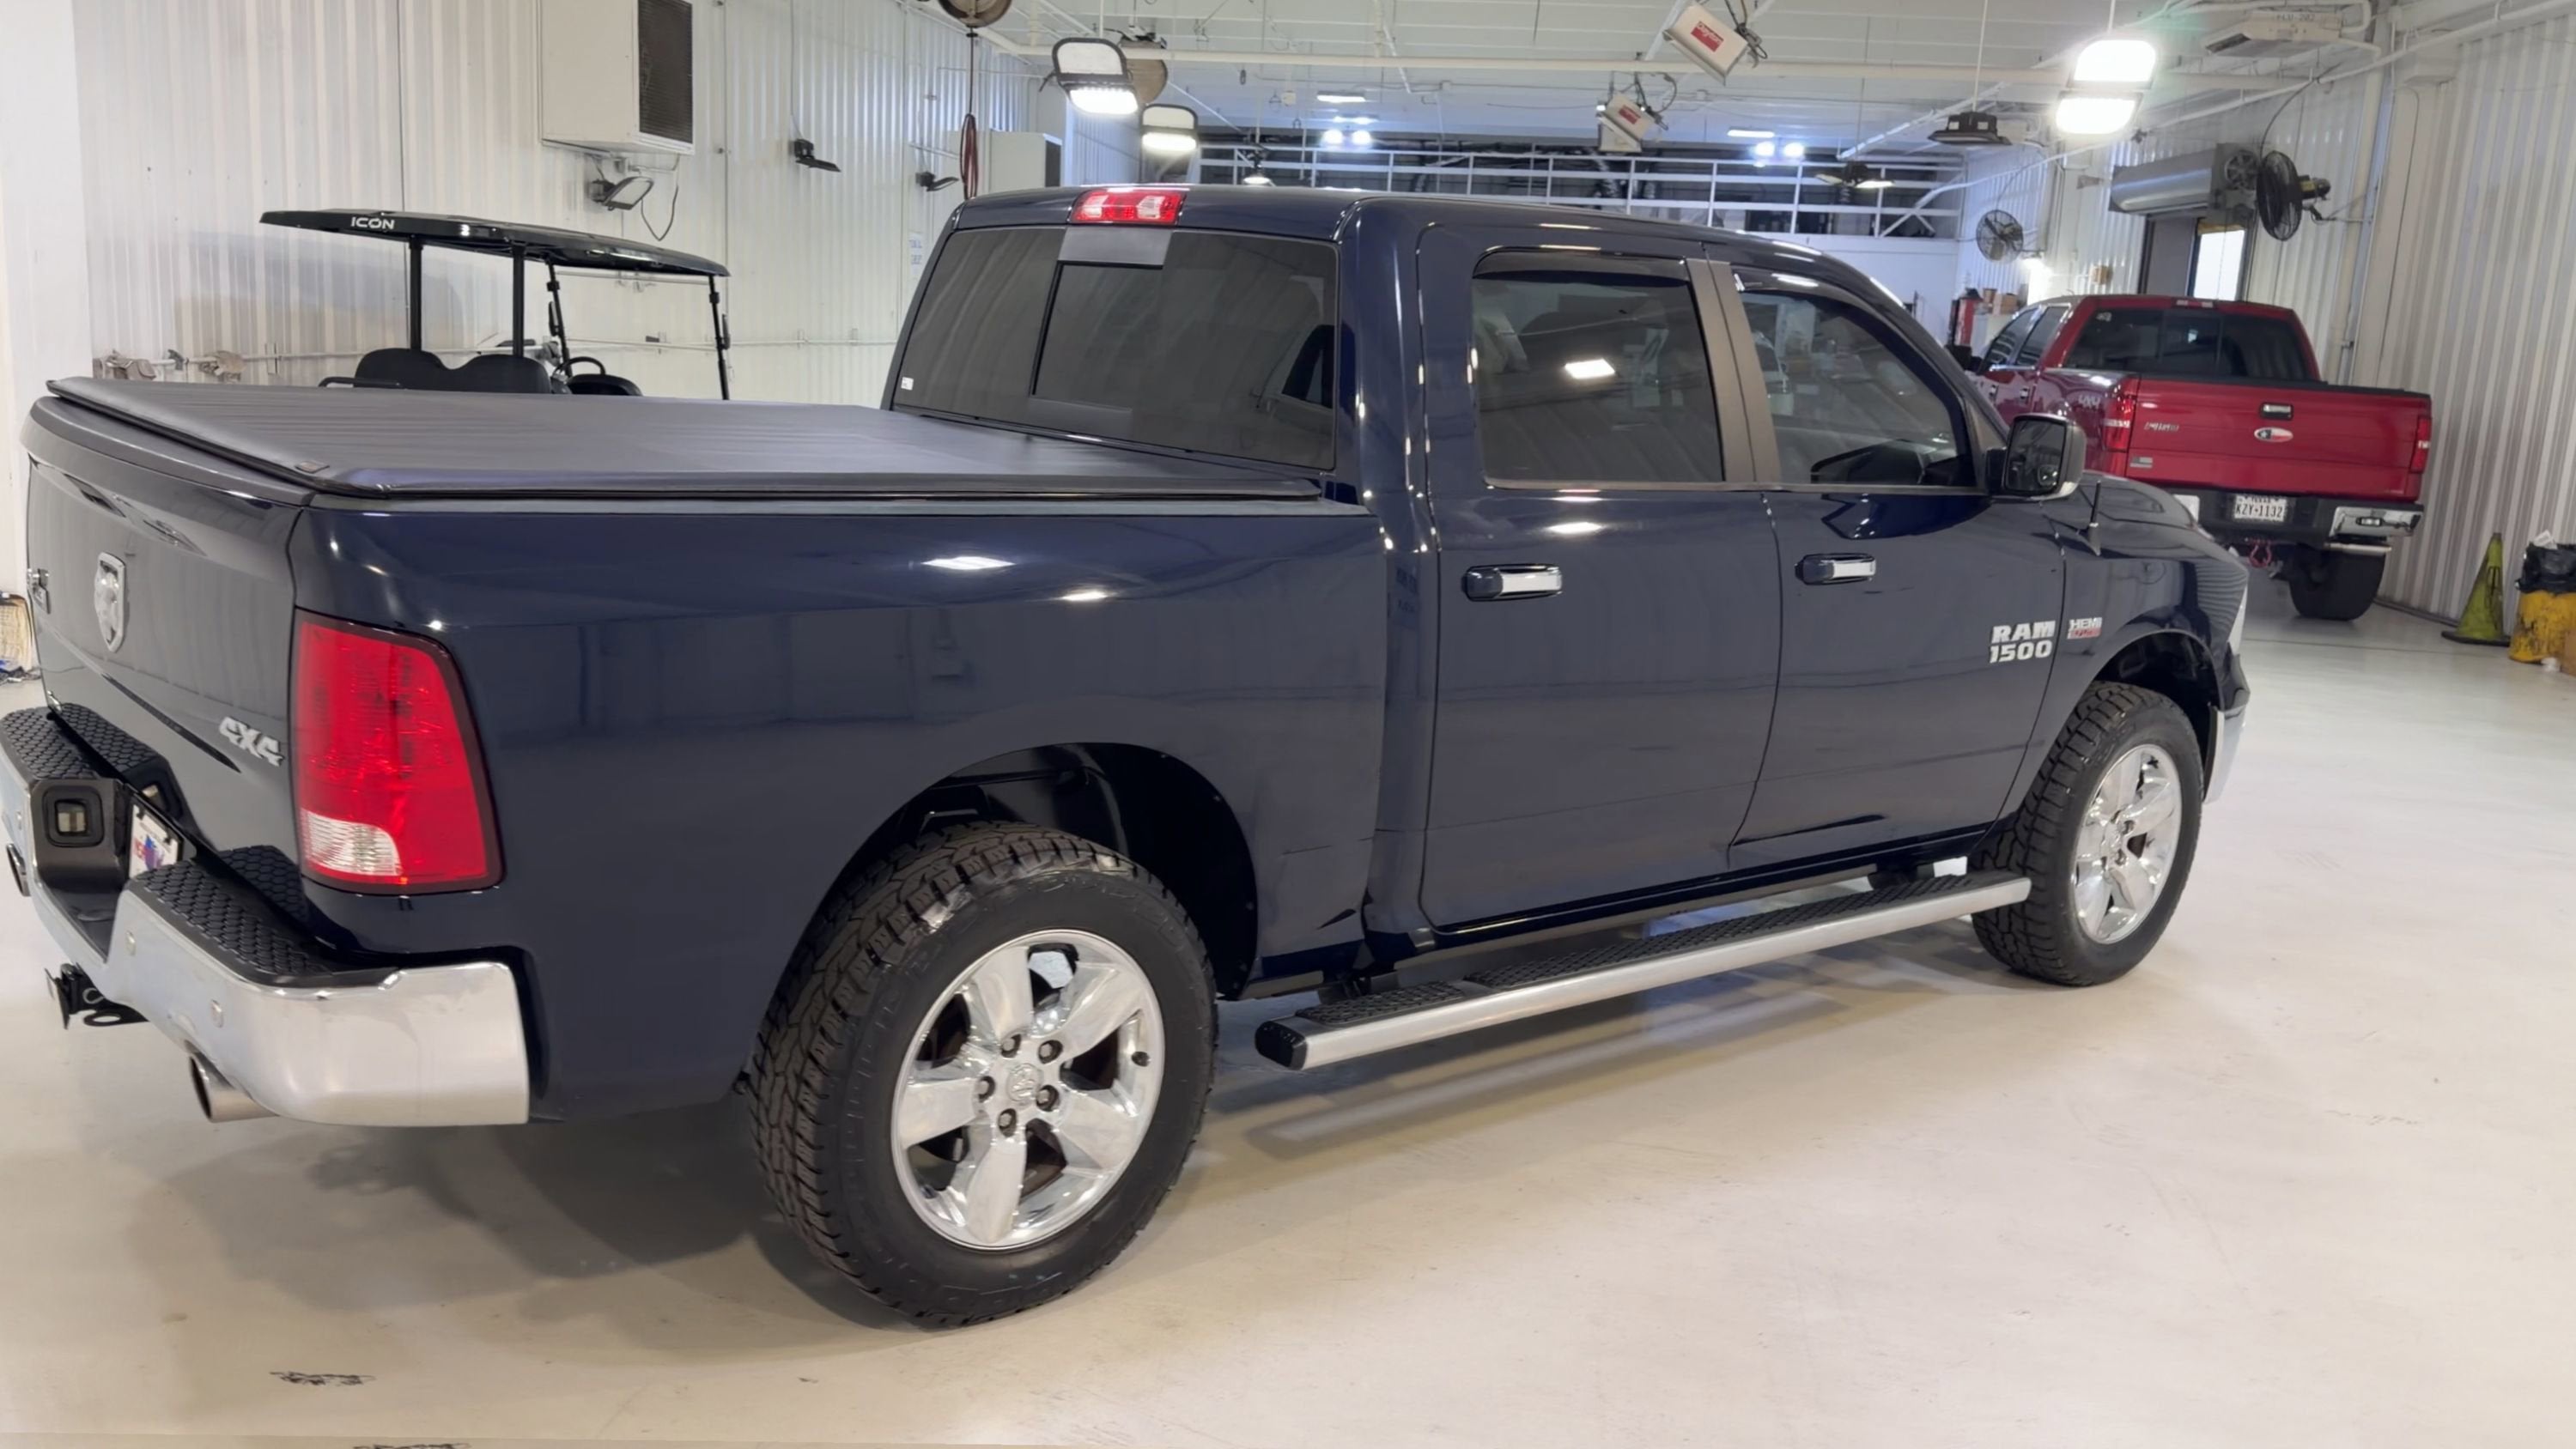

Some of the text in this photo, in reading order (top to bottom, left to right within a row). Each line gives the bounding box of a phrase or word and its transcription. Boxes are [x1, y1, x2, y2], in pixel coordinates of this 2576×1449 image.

[350, 216, 395, 230] ICON
[1991, 620, 2056, 644] RAM
[1990, 640, 2053, 664] 1500
